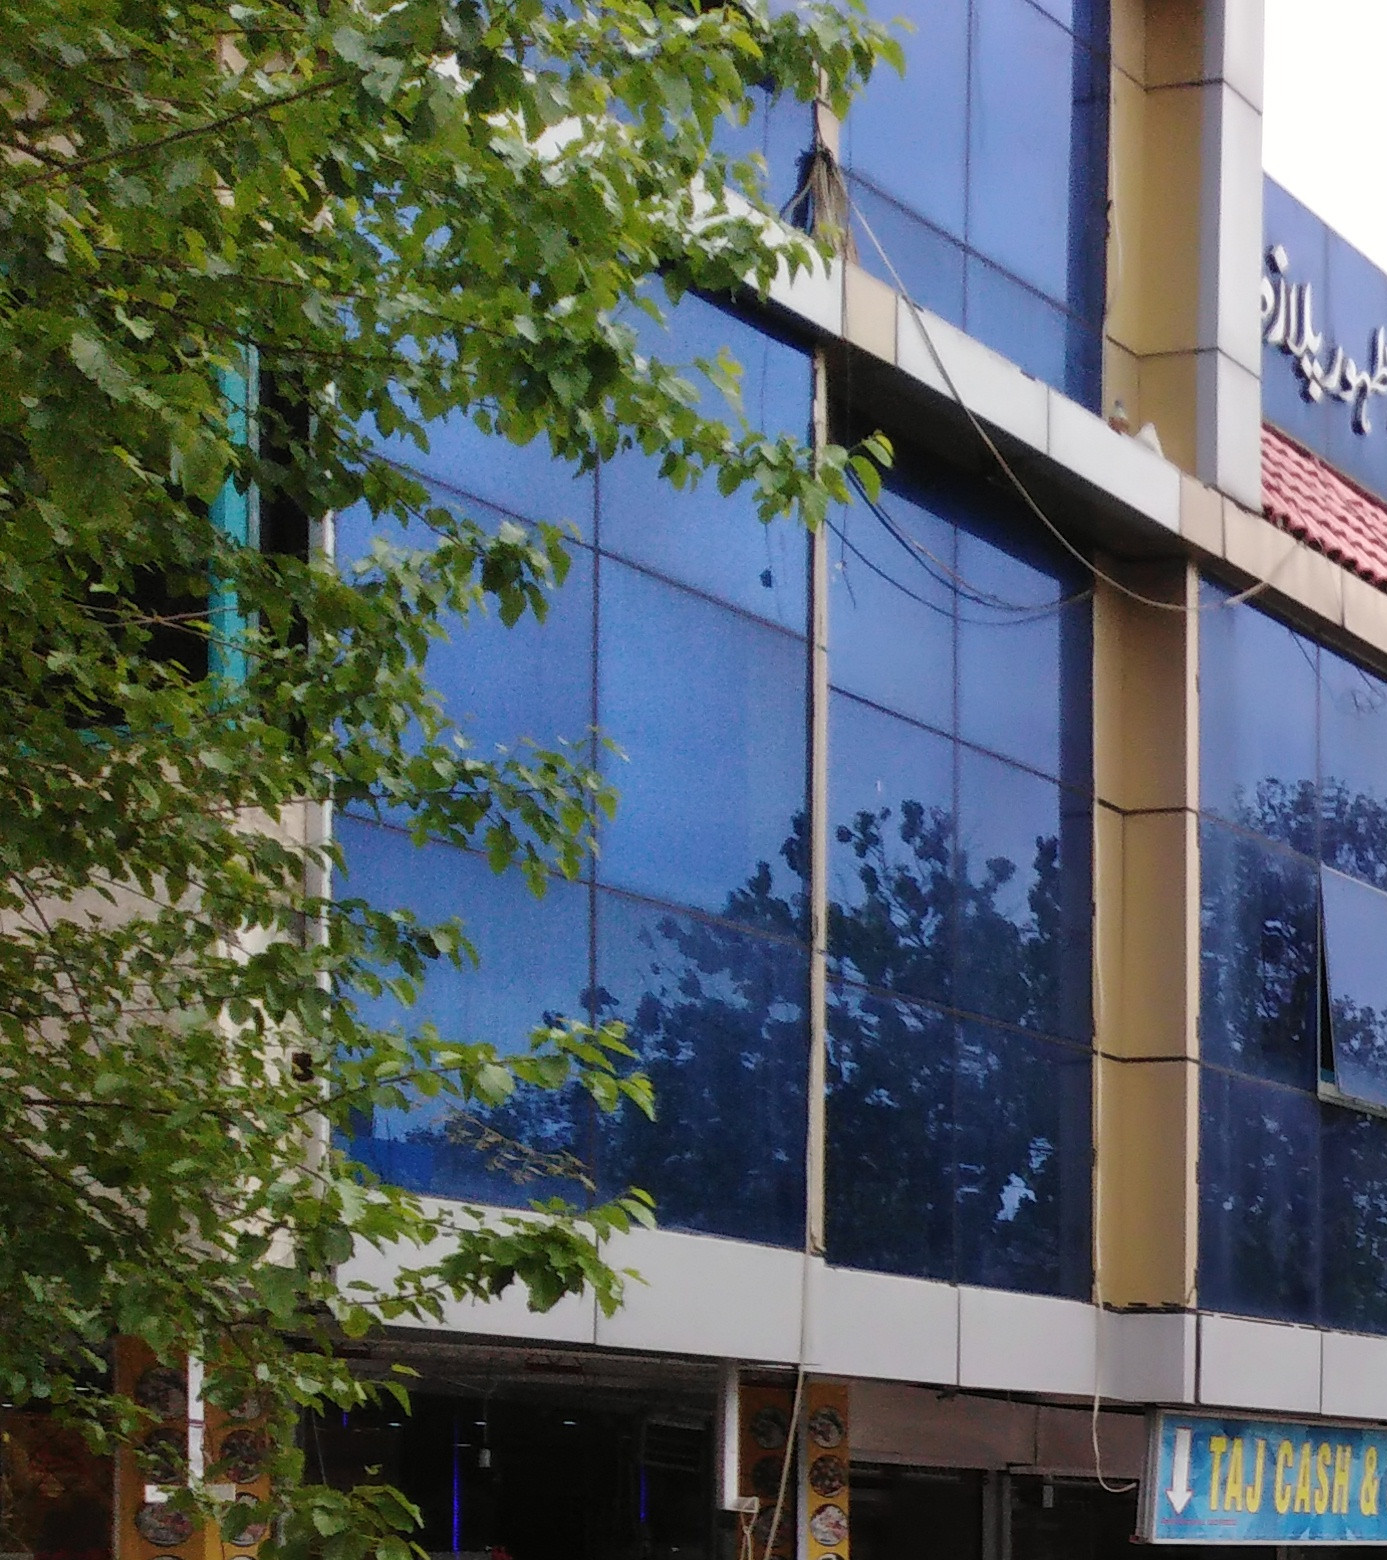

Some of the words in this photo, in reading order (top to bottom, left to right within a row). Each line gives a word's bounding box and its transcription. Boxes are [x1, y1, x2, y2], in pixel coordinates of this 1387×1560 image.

[1208, 1435, 1265, 1515] TAJ
[1275, 1440, 1351, 1517] CASH
[1360, 1444, 1382, 1517] &
